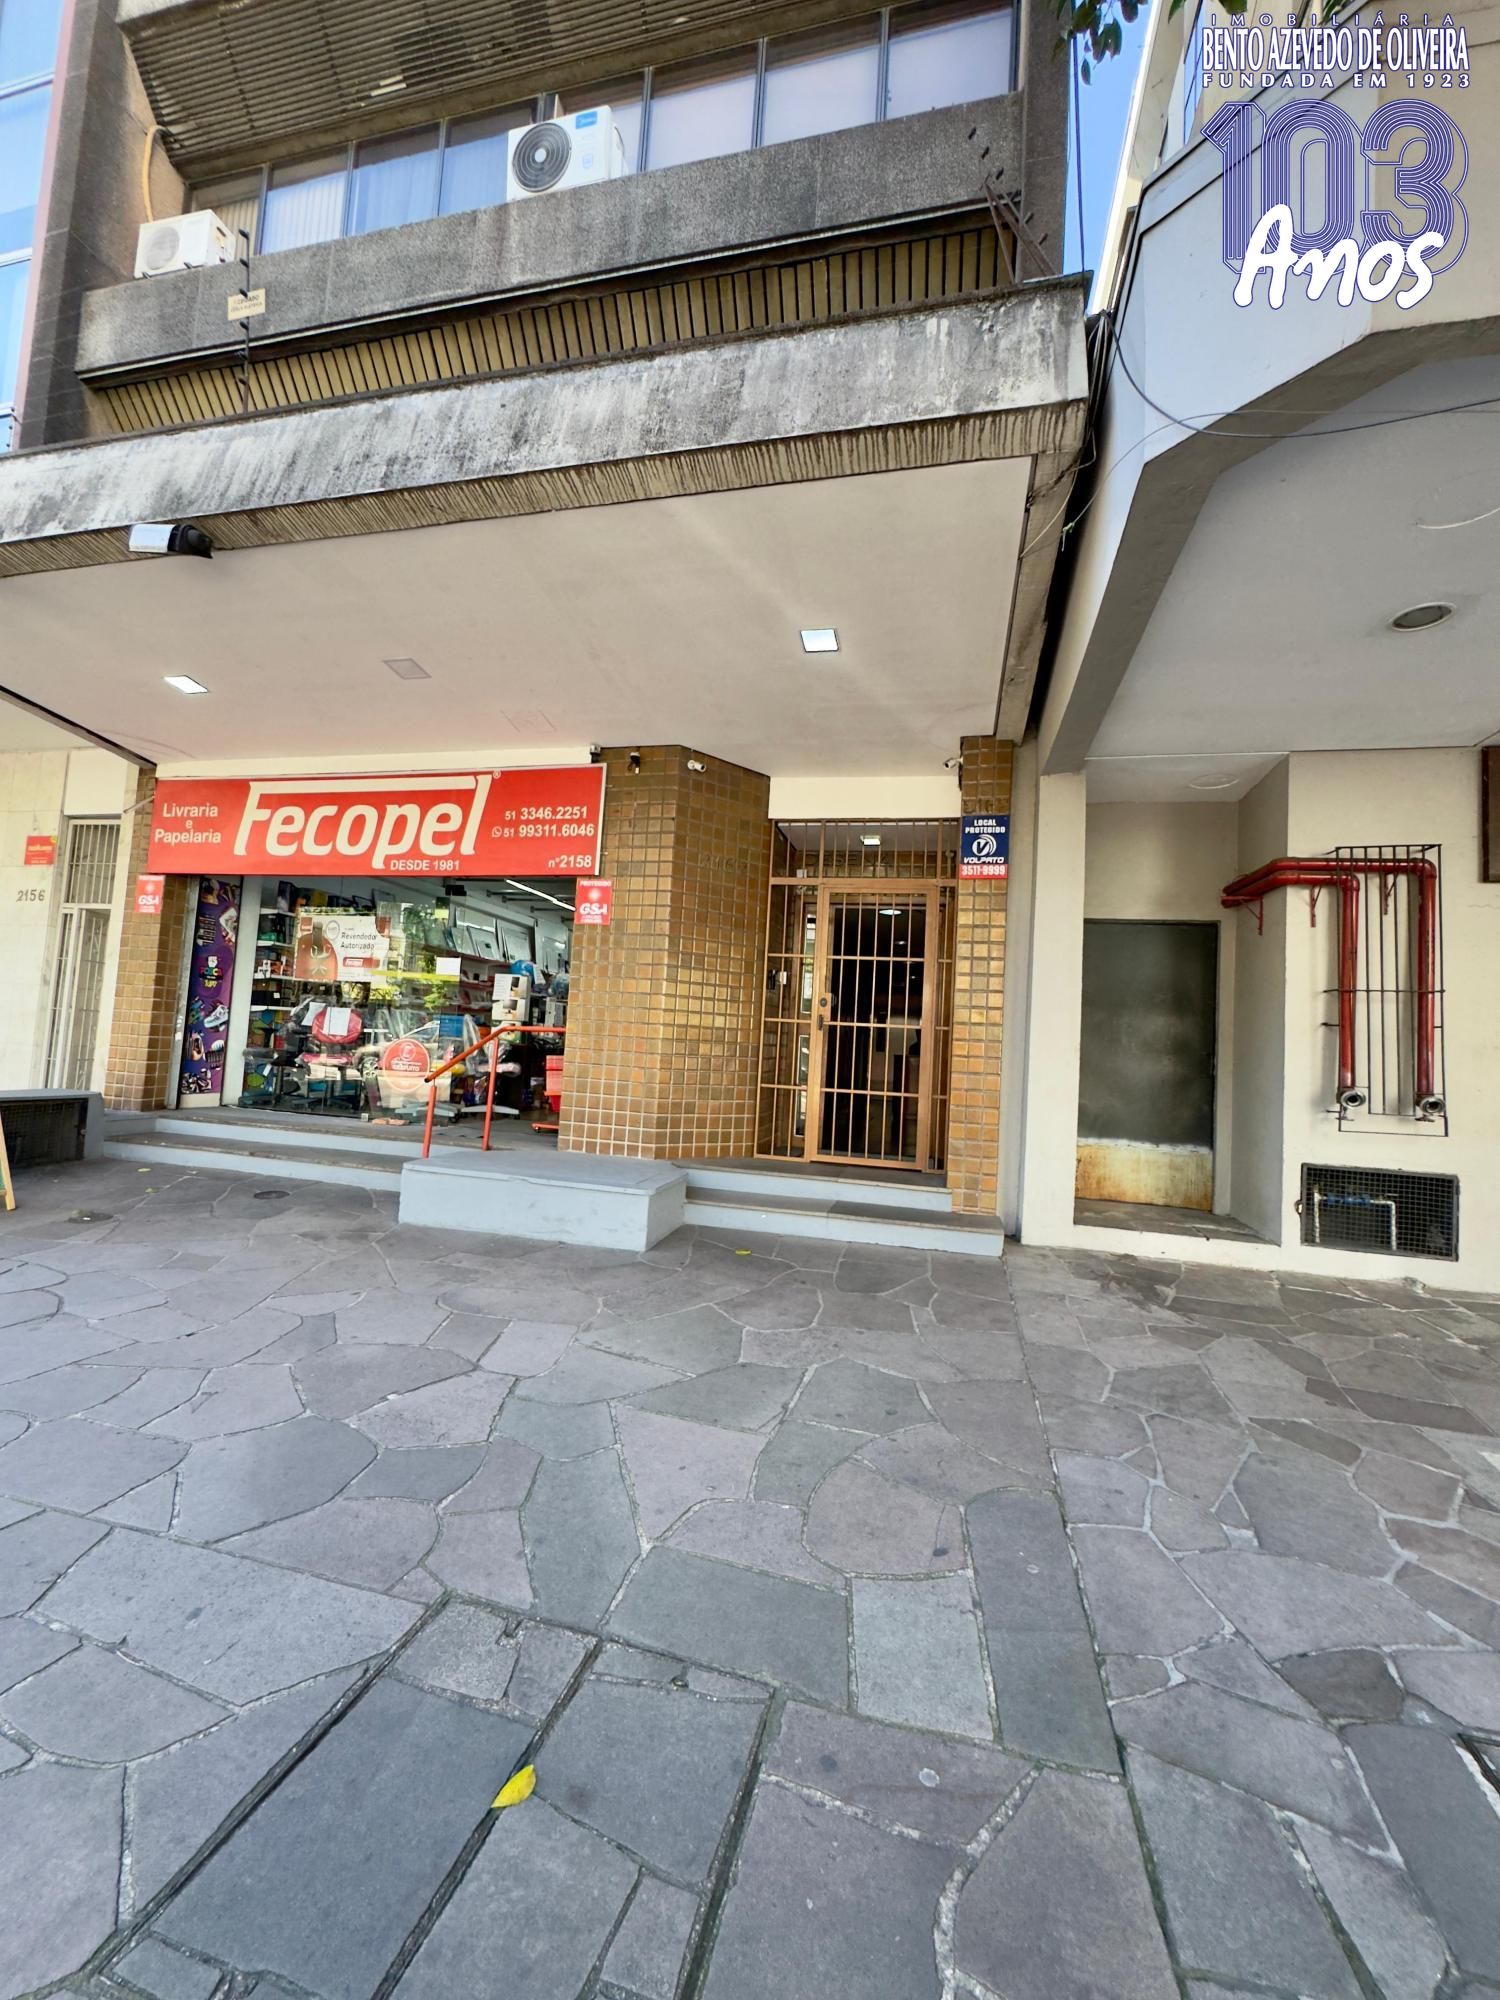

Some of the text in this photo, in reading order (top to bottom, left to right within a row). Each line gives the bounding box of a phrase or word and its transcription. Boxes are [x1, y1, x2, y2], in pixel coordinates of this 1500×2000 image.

[163, 803, 219, 818] Livraria
[505, 806, 588, 820] 51 3346.2251
[186, 820, 193, 829] e
[233, 774, 493, 870] Fecopel
[154, 828, 222, 846] Papelaria
[503, 823, 595, 838] 51 99311.6046
[390, 859, 460, 871] DESDE 1981
[963, 856, 1005, 864] VOLPATO
[962, 864, 1006, 876] 3511-9999
[16, 889, 45, 903] 2156
